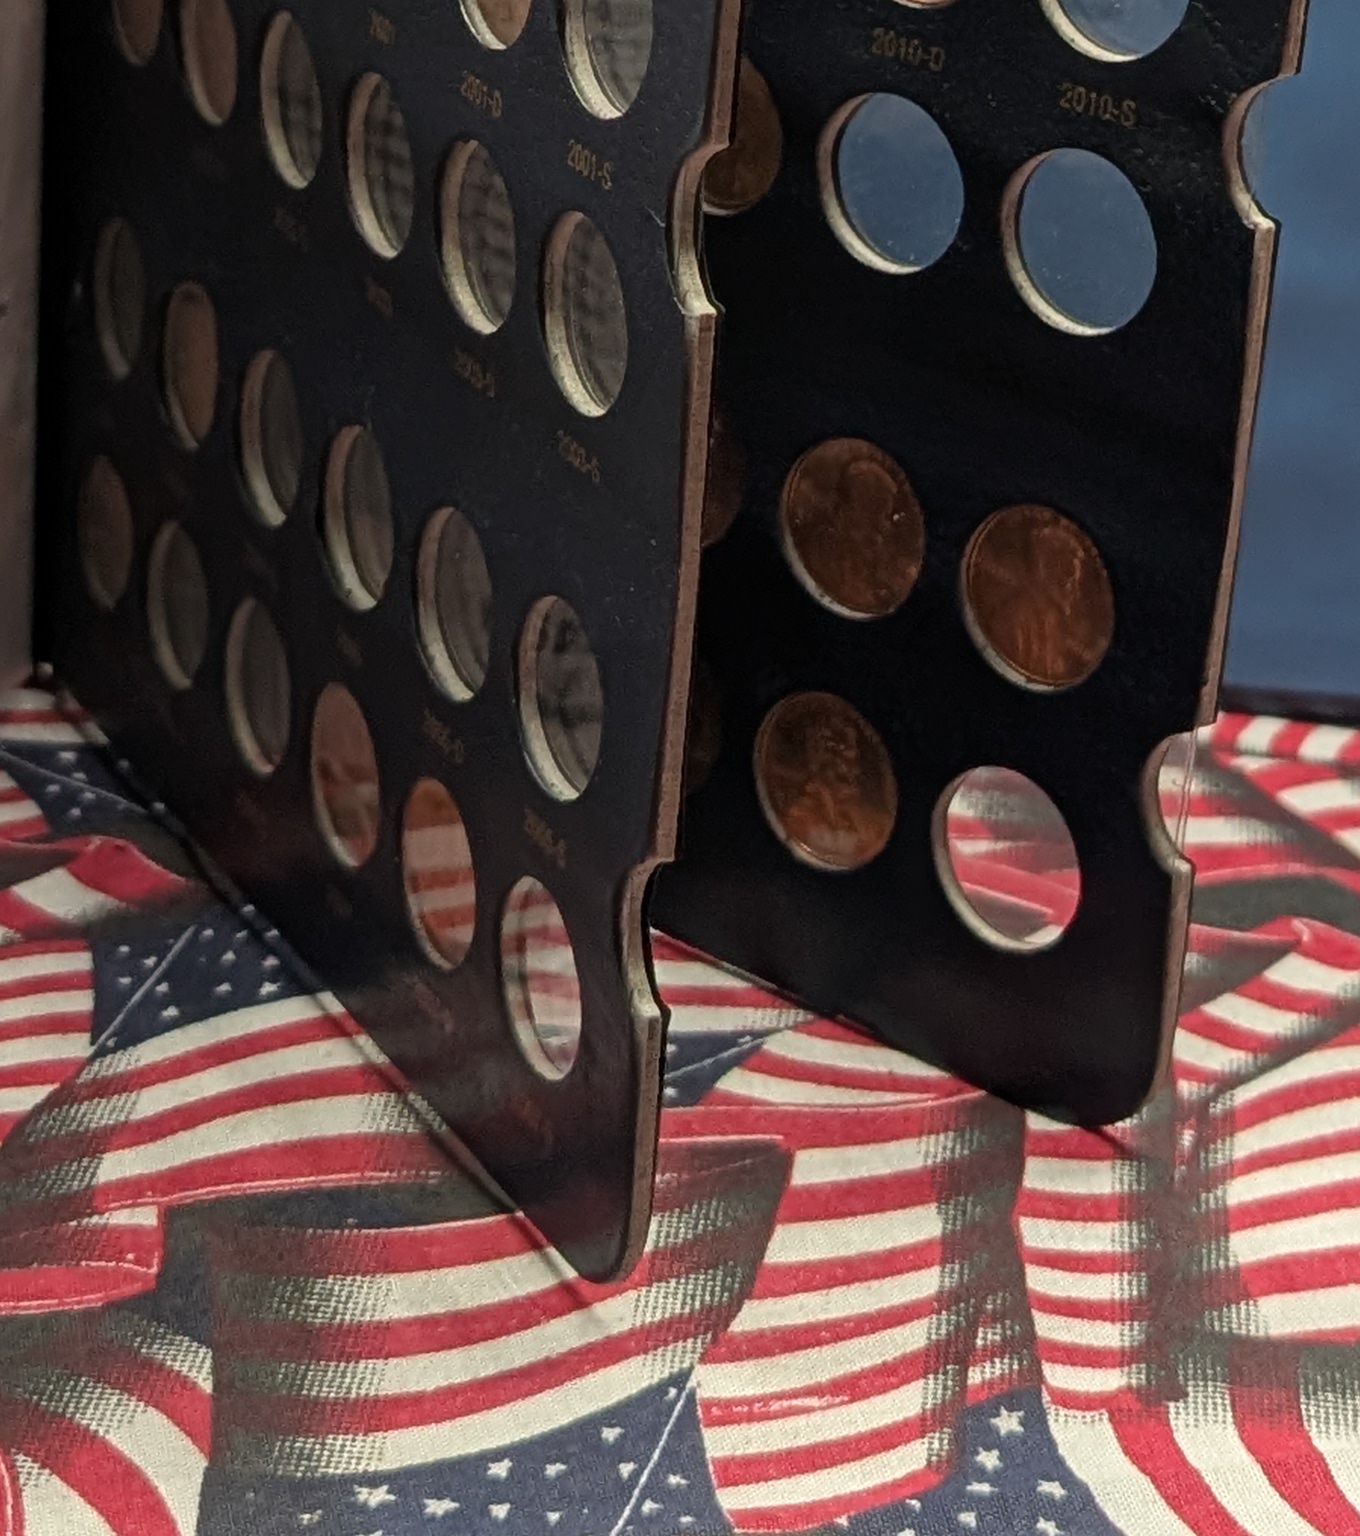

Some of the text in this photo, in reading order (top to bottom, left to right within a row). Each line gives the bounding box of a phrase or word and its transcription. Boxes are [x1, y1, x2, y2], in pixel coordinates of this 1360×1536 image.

[869, 26, 946, 73] 2010-D
[1058, 81, 1139, 128] 2010-S
[565, 138, 614, 192] 2001-S
